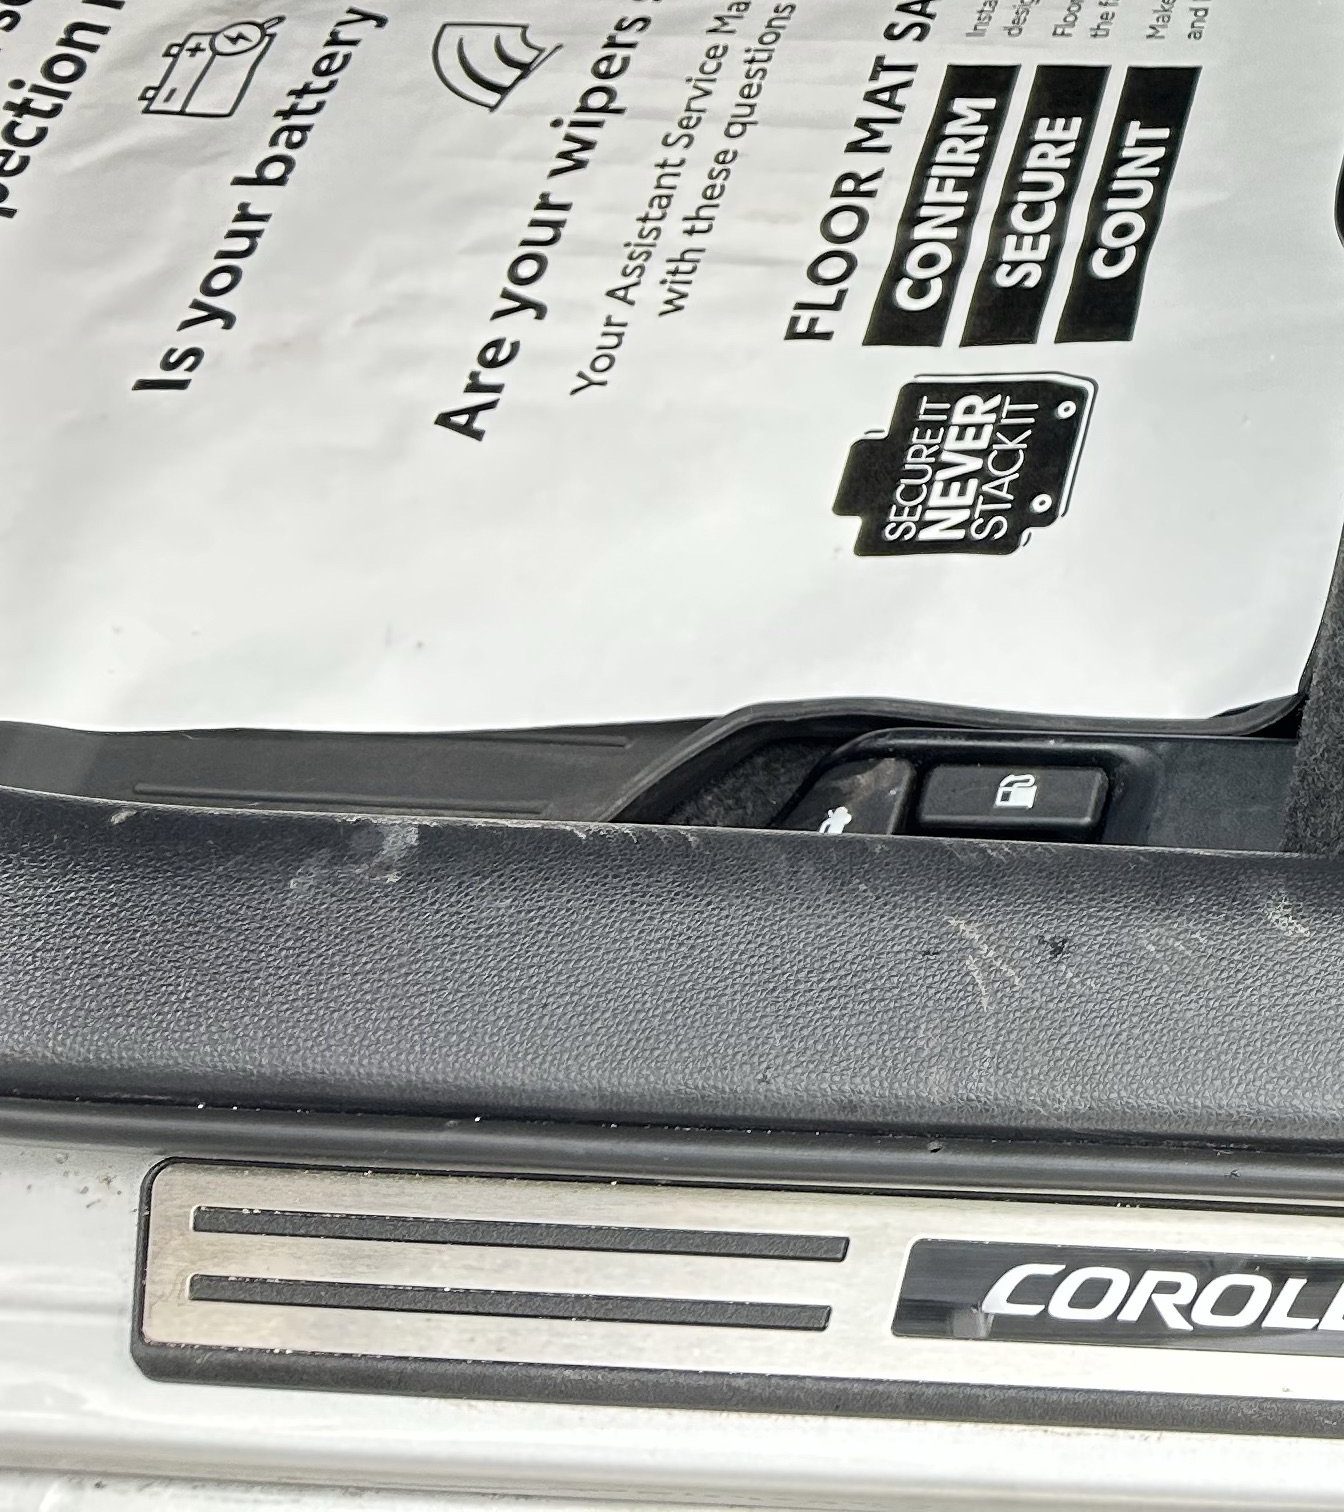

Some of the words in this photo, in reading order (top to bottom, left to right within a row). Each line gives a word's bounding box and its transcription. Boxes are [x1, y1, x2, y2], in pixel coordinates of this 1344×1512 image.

[1090, 7, 1116, 38] the
[1187, 6, 1209, 41] and
[131, 344, 205, 391] Is
[177, 202, 272, 331] your
[231, 5, 388, 187] battery
[433, 341, 520, 441] Are
[489, 191, 573, 321] your
[547, 16, 652, 179] wipers
[569, 314, 629, 396] Your
[605, 154, 686, 306] Assistant
[661, 43, 729, 150] Service
[658, 248, 706, 317] with
[682, 148, 738, 236] these
[724, 2, 796, 139] questions
[784, 167, 885, 340] FLOOR
[844, 54, 918, 154] MAT
[894, 96, 997, 312] CONFIRM
[994, 115, 1082, 288] SECURE
[1090, 120, 1171, 280] COUNT
[884, 427, 945, 541] SECURE
[918, 395, 951, 423] IT
[917, 394, 1002, 542] NEVER
[970, 429, 1032, 541] STACK
[1001, 396, 1039, 424] IT
